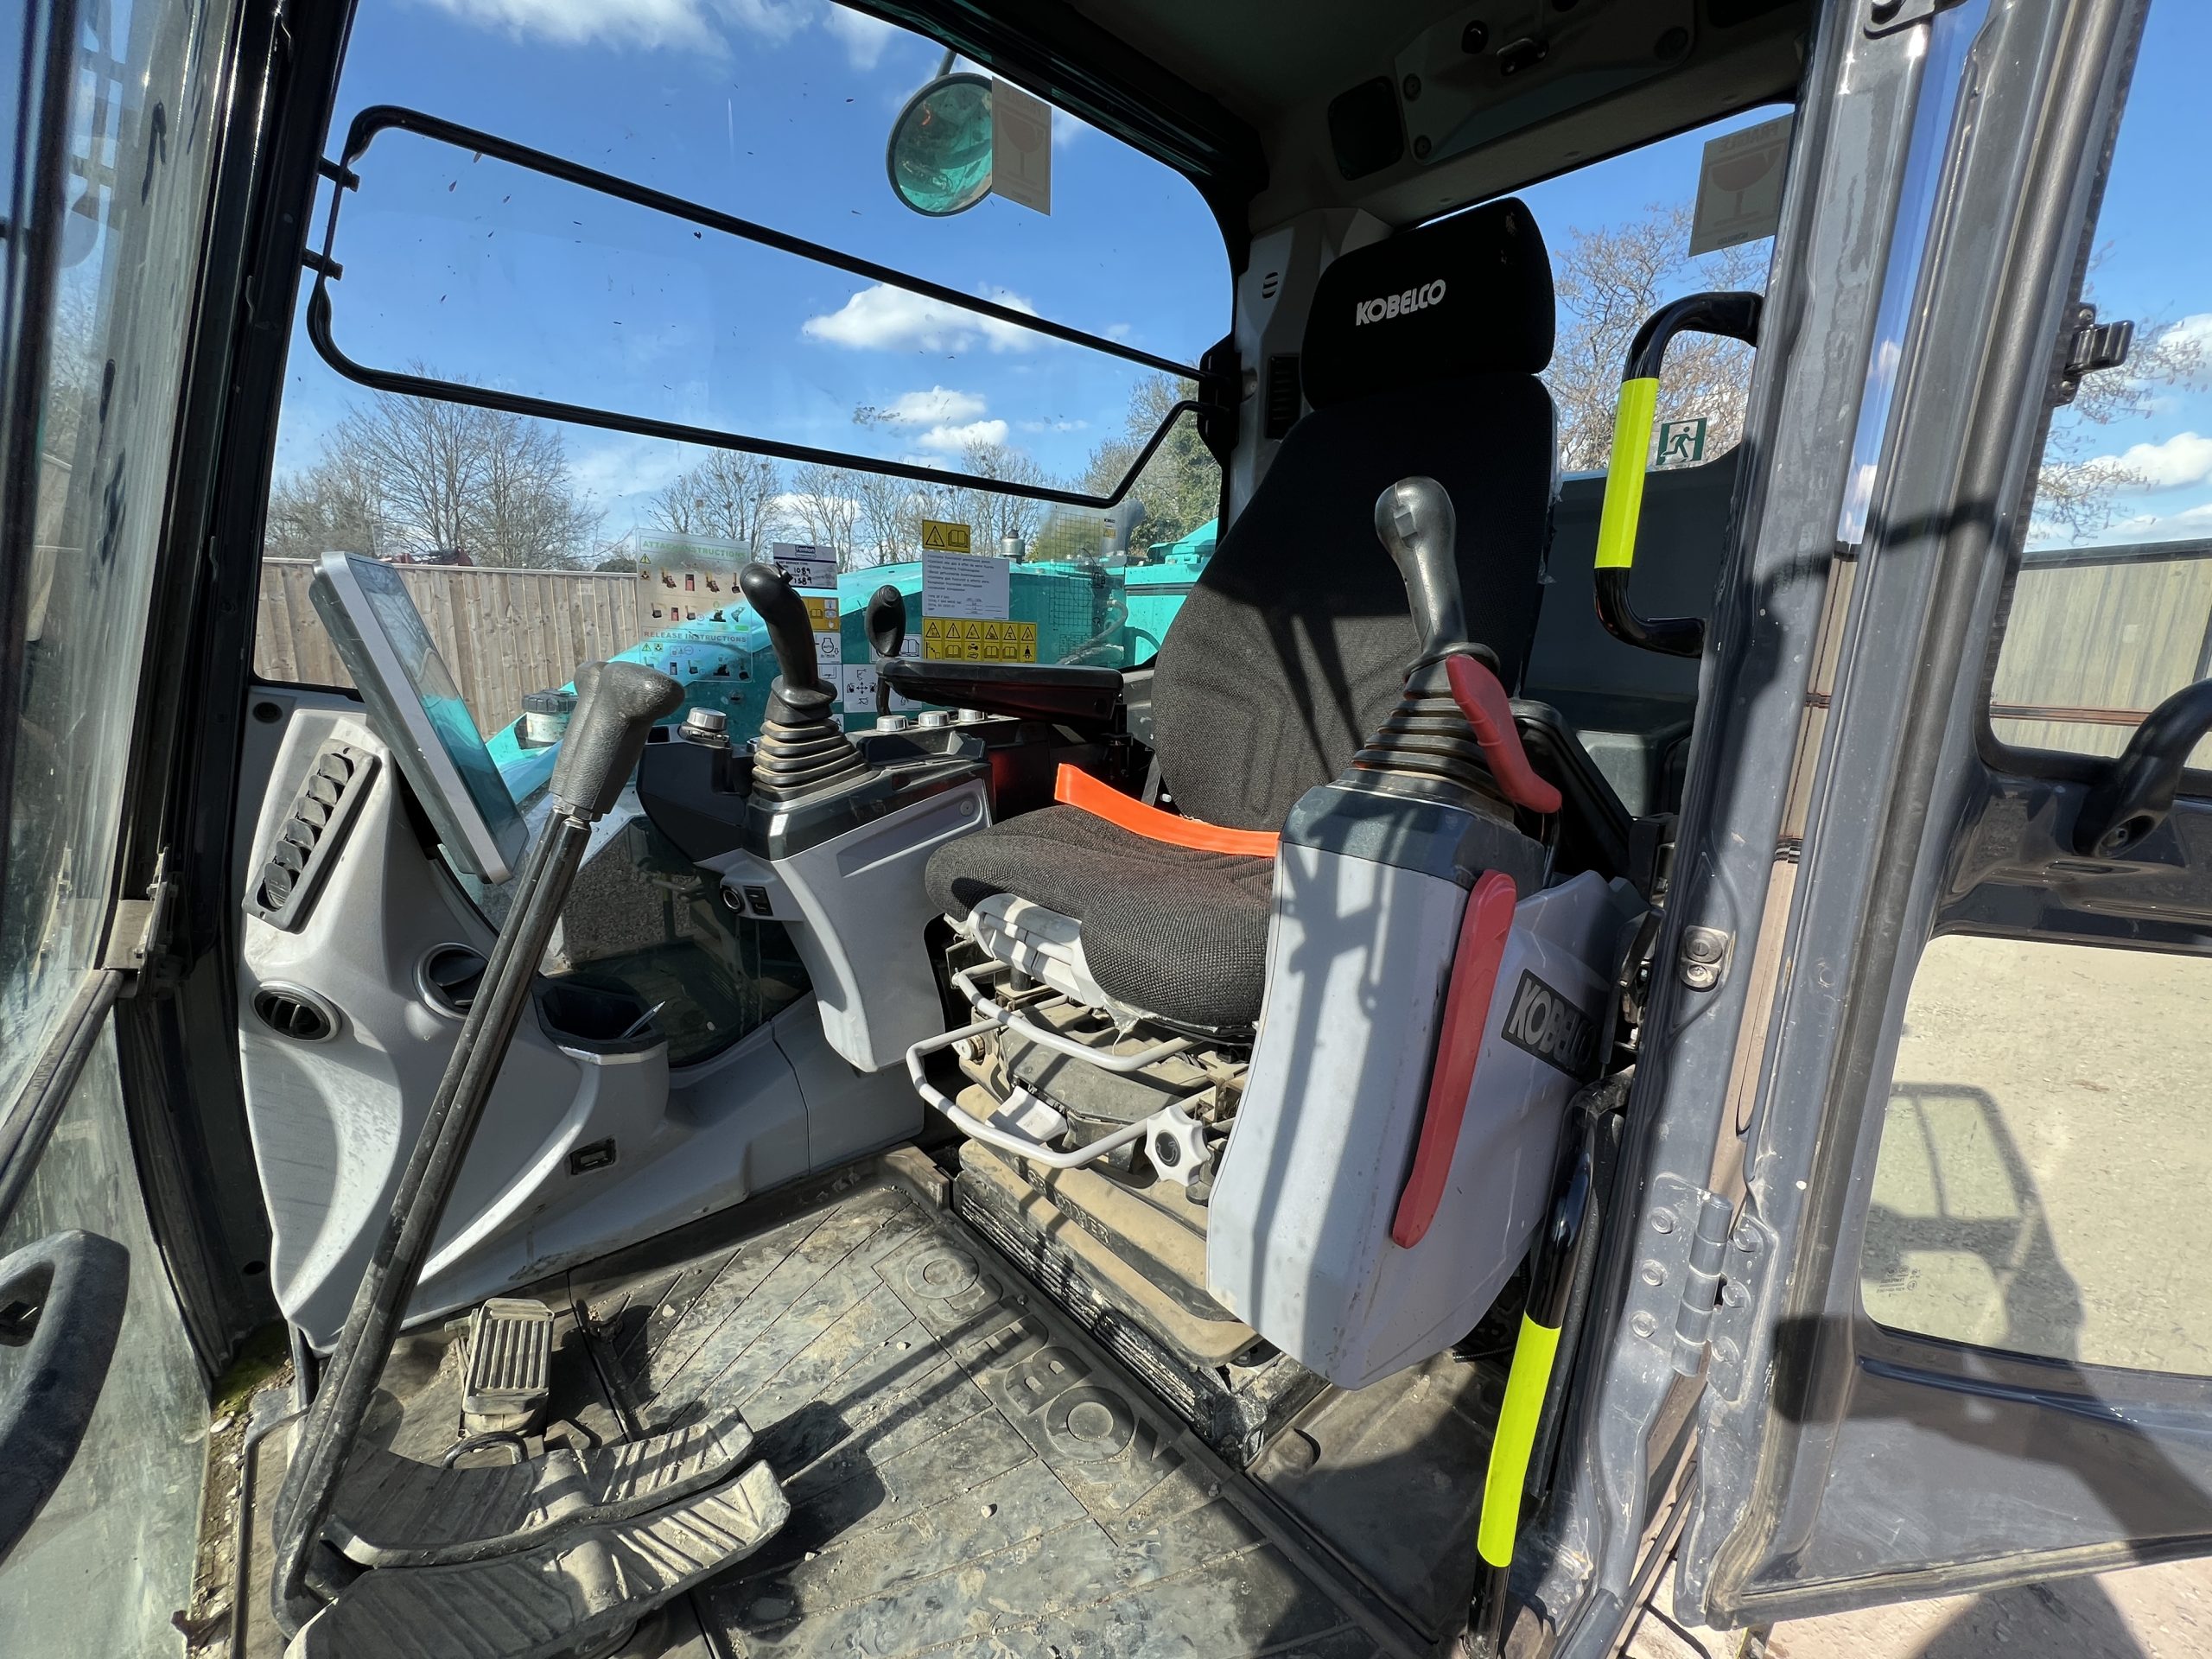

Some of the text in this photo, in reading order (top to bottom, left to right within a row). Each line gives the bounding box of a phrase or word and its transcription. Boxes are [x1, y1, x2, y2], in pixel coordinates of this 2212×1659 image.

[1355, 278, 1446, 326] KOBELCO
[793, 567, 811, 575] 1089
[793, 576, 813, 586] 1589
[644, 631, 747, 643] RELEASE INSTRUCTIONS
